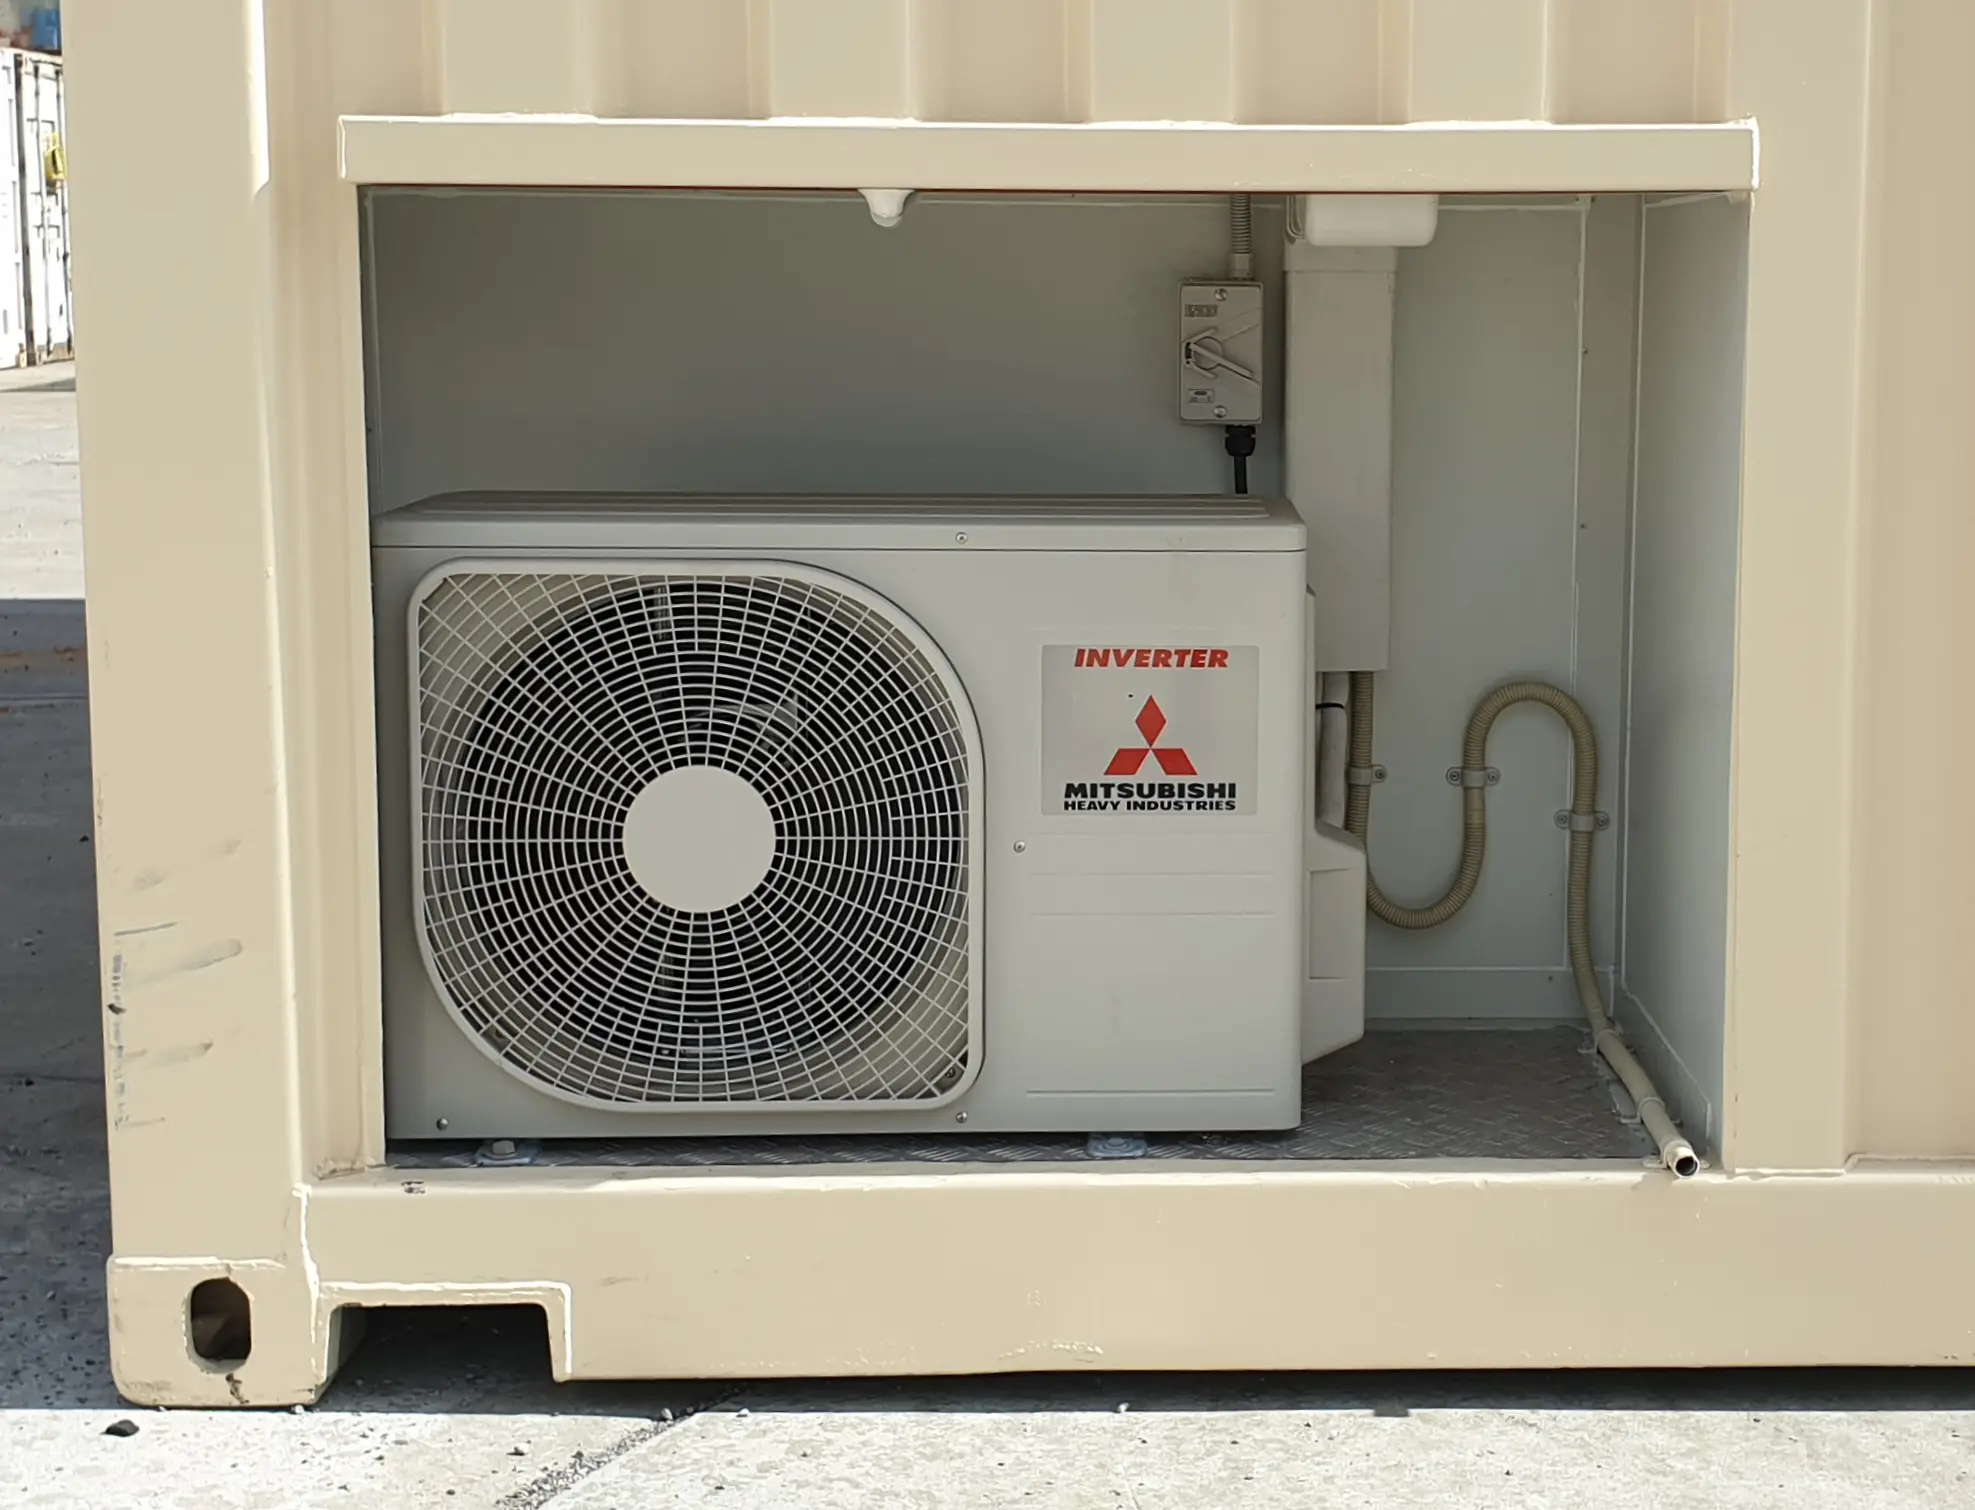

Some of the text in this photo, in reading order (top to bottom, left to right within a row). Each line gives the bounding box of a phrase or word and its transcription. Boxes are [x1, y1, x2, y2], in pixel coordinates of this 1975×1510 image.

[1074, 648, 1229, 668] INVERTER
[1064, 783, 1236, 799] MITSUBISHI
[1063, 800, 1236, 811] HEAVY INDUSTRIES
